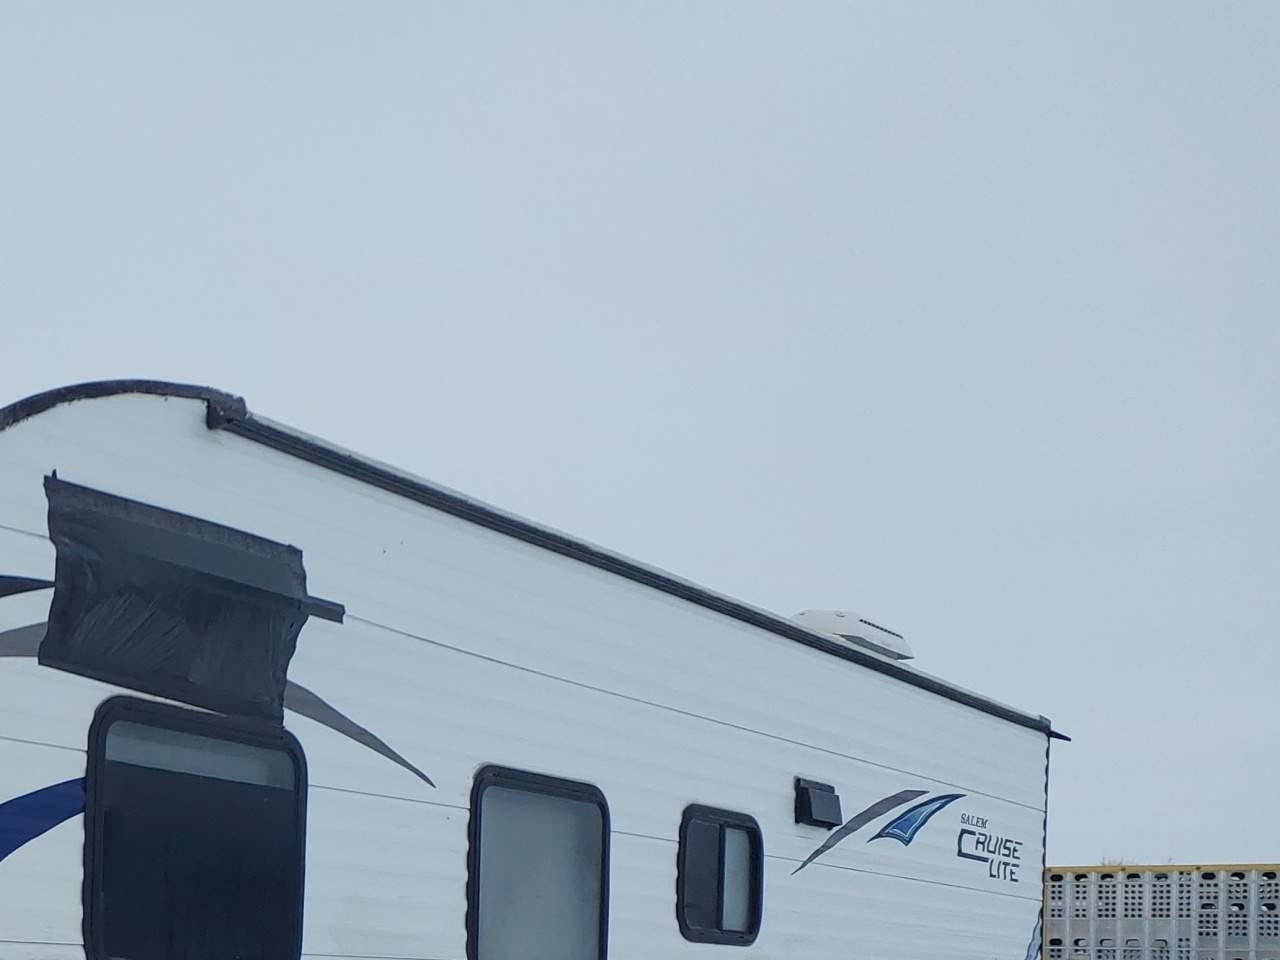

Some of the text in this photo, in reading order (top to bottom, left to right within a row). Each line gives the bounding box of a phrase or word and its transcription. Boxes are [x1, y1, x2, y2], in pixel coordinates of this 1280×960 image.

[960, 813, 988, 828] SALEM
[958, 829, 1023, 862] CRUISE
[989, 859, 1020, 882] LITE
